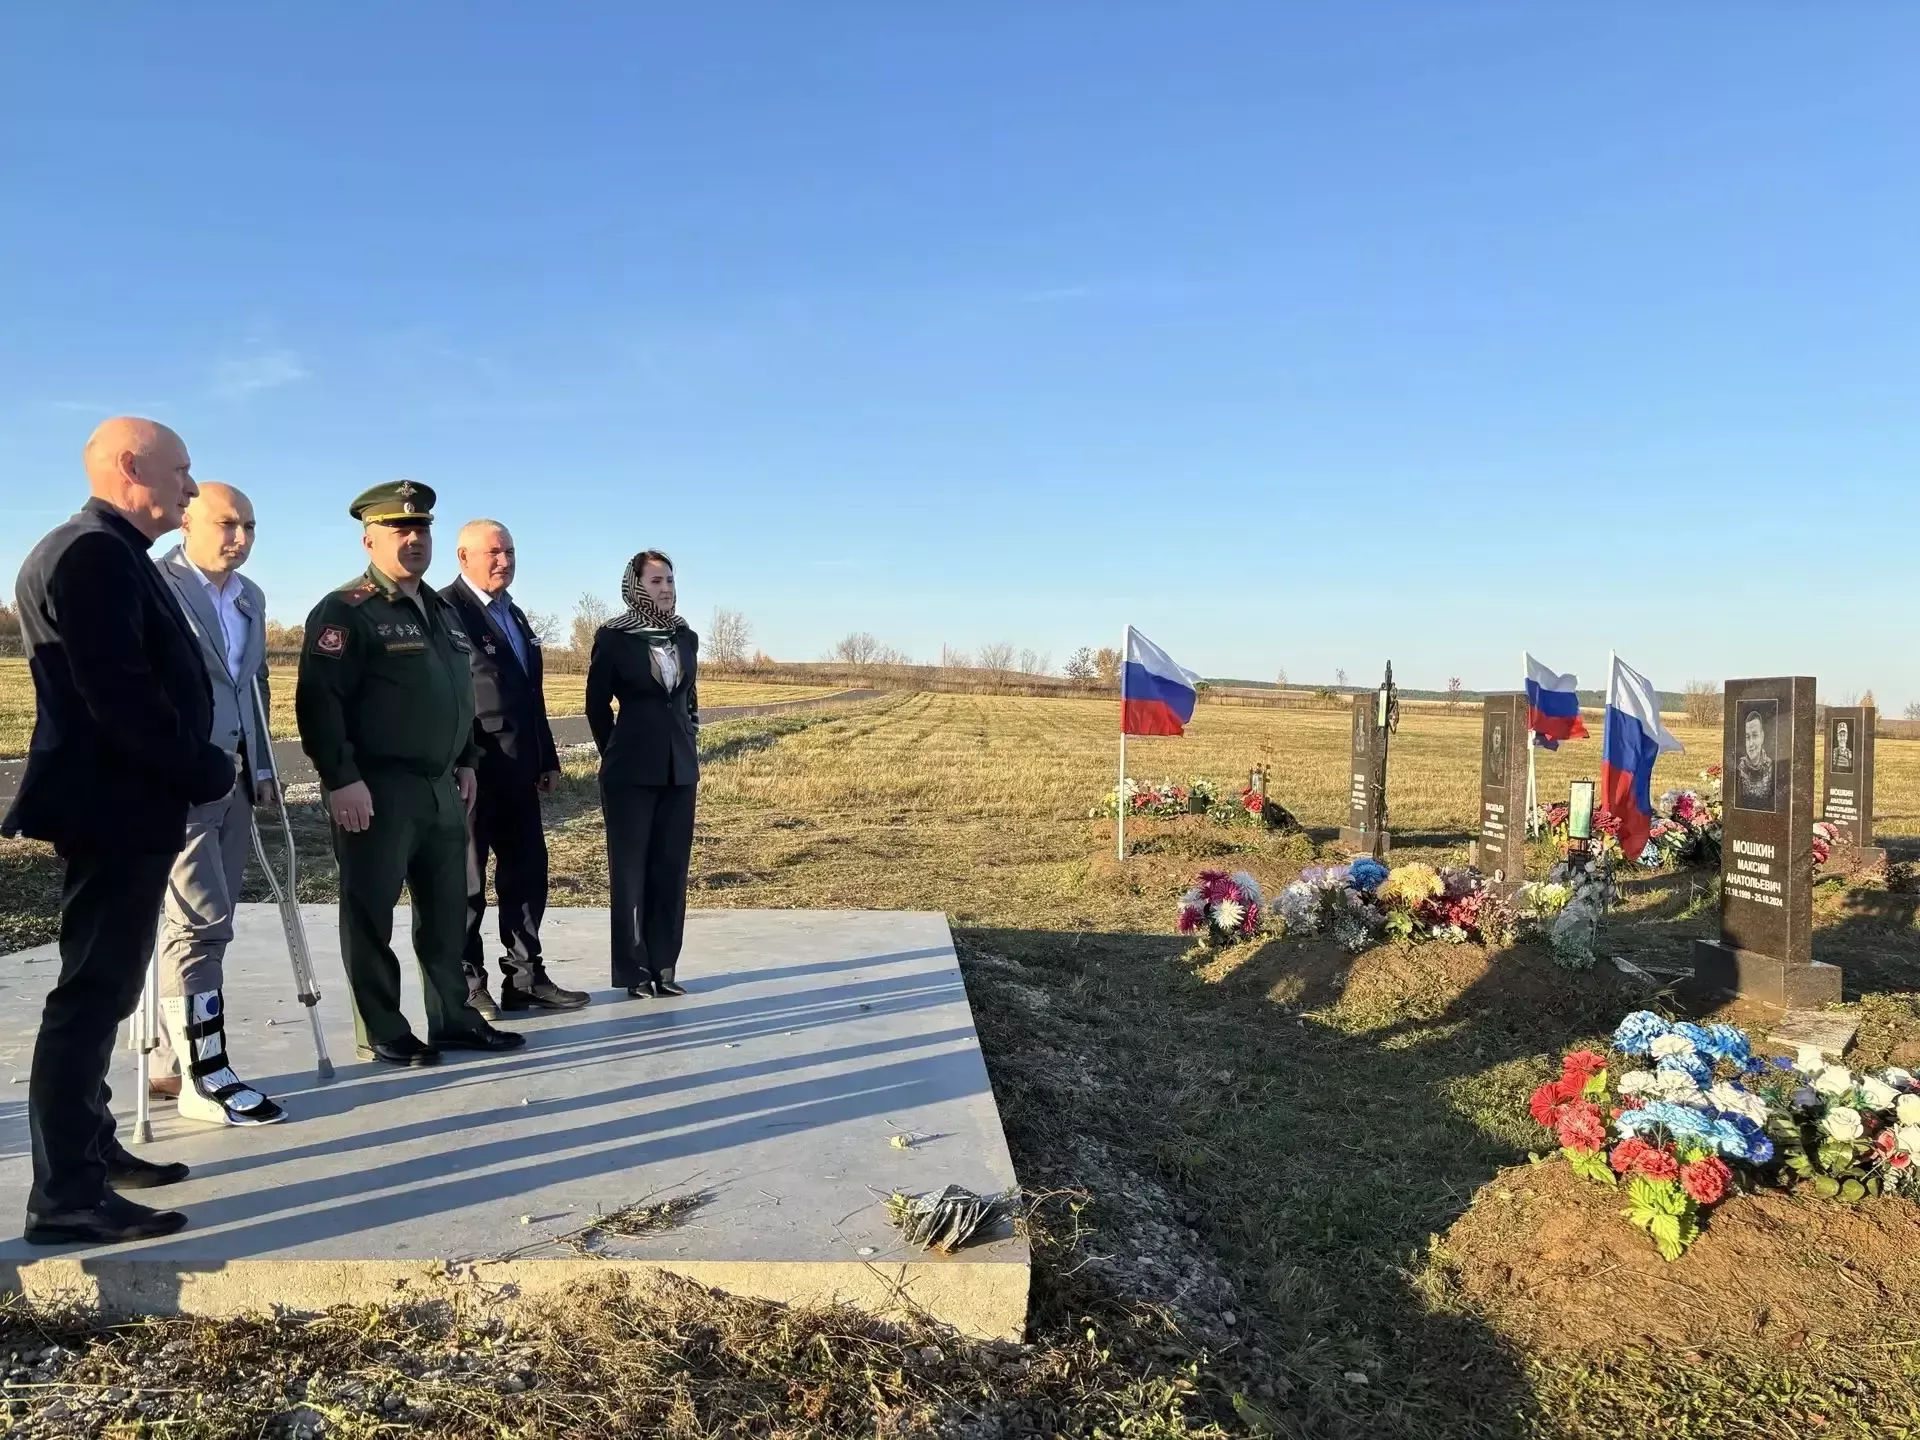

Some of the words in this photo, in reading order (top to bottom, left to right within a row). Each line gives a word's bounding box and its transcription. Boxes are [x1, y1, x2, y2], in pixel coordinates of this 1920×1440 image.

[1733, 839, 1775, 859] МОШКИН
[1737, 859, 1770, 875] МАКСИМ
[1726, 872, 1782, 893] АНАТОЛЬЕВИЧ
